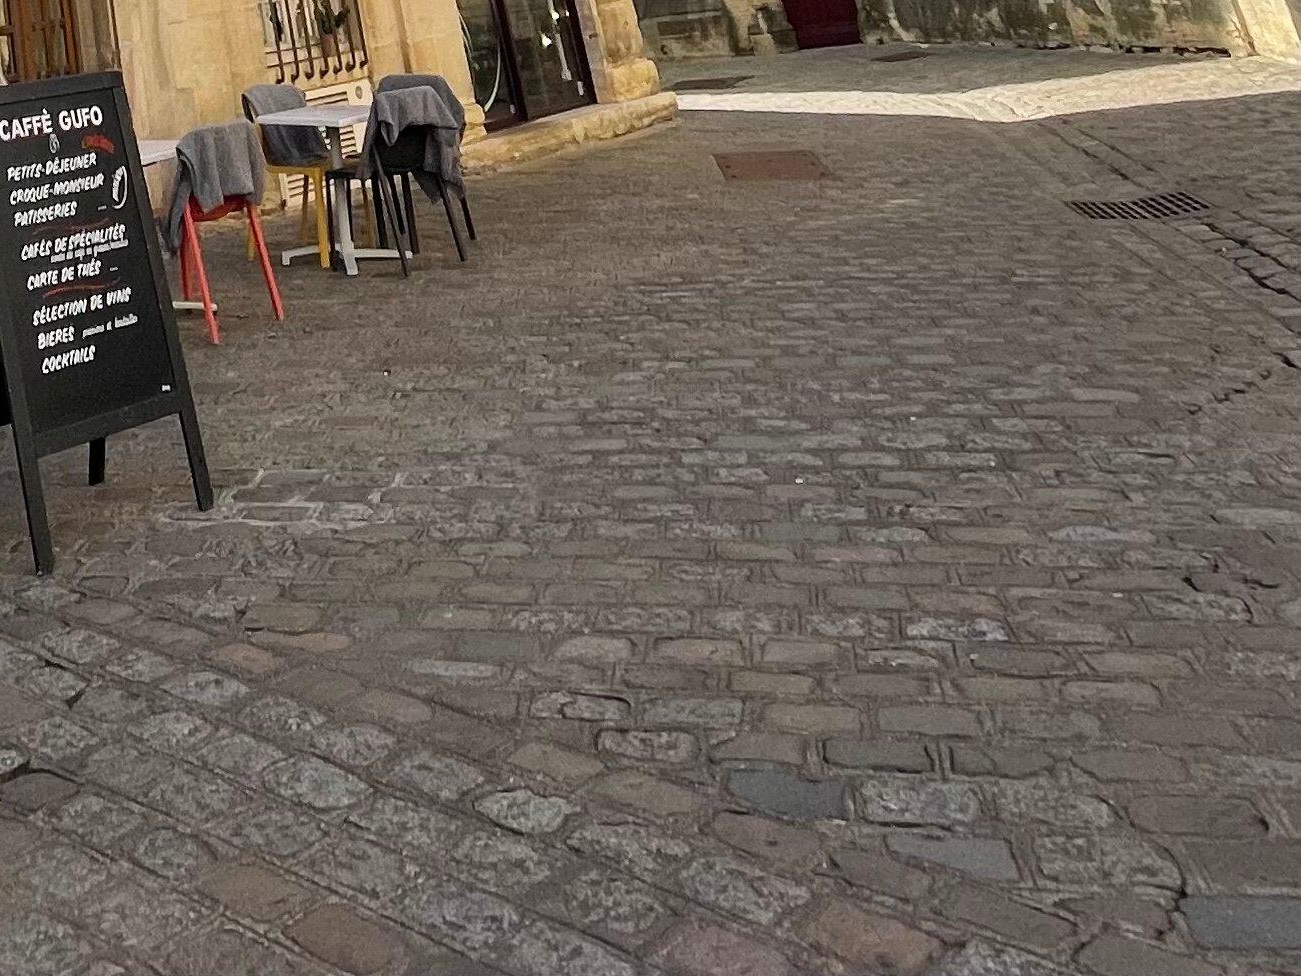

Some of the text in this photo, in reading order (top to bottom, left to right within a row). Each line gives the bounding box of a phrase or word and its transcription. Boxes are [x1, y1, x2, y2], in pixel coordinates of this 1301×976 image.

[59, 105, 103, 131] GUFO
[9, 173, 105, 206] CROQUE-MONSIEUR
[14, 201, 78, 227] PATISSERIES
[21, 238, 52, 261] CAFÉS
[54, 236, 68, 253] DE
[68, 223, 126, 250] SPÉCIALITÉS
[26, 258, 102, 291] CARTE DE THÉS
[33, 286, 132, 326] SÉLECTION DE VINS
[41, 345, 96, 374] COCKTAILS
